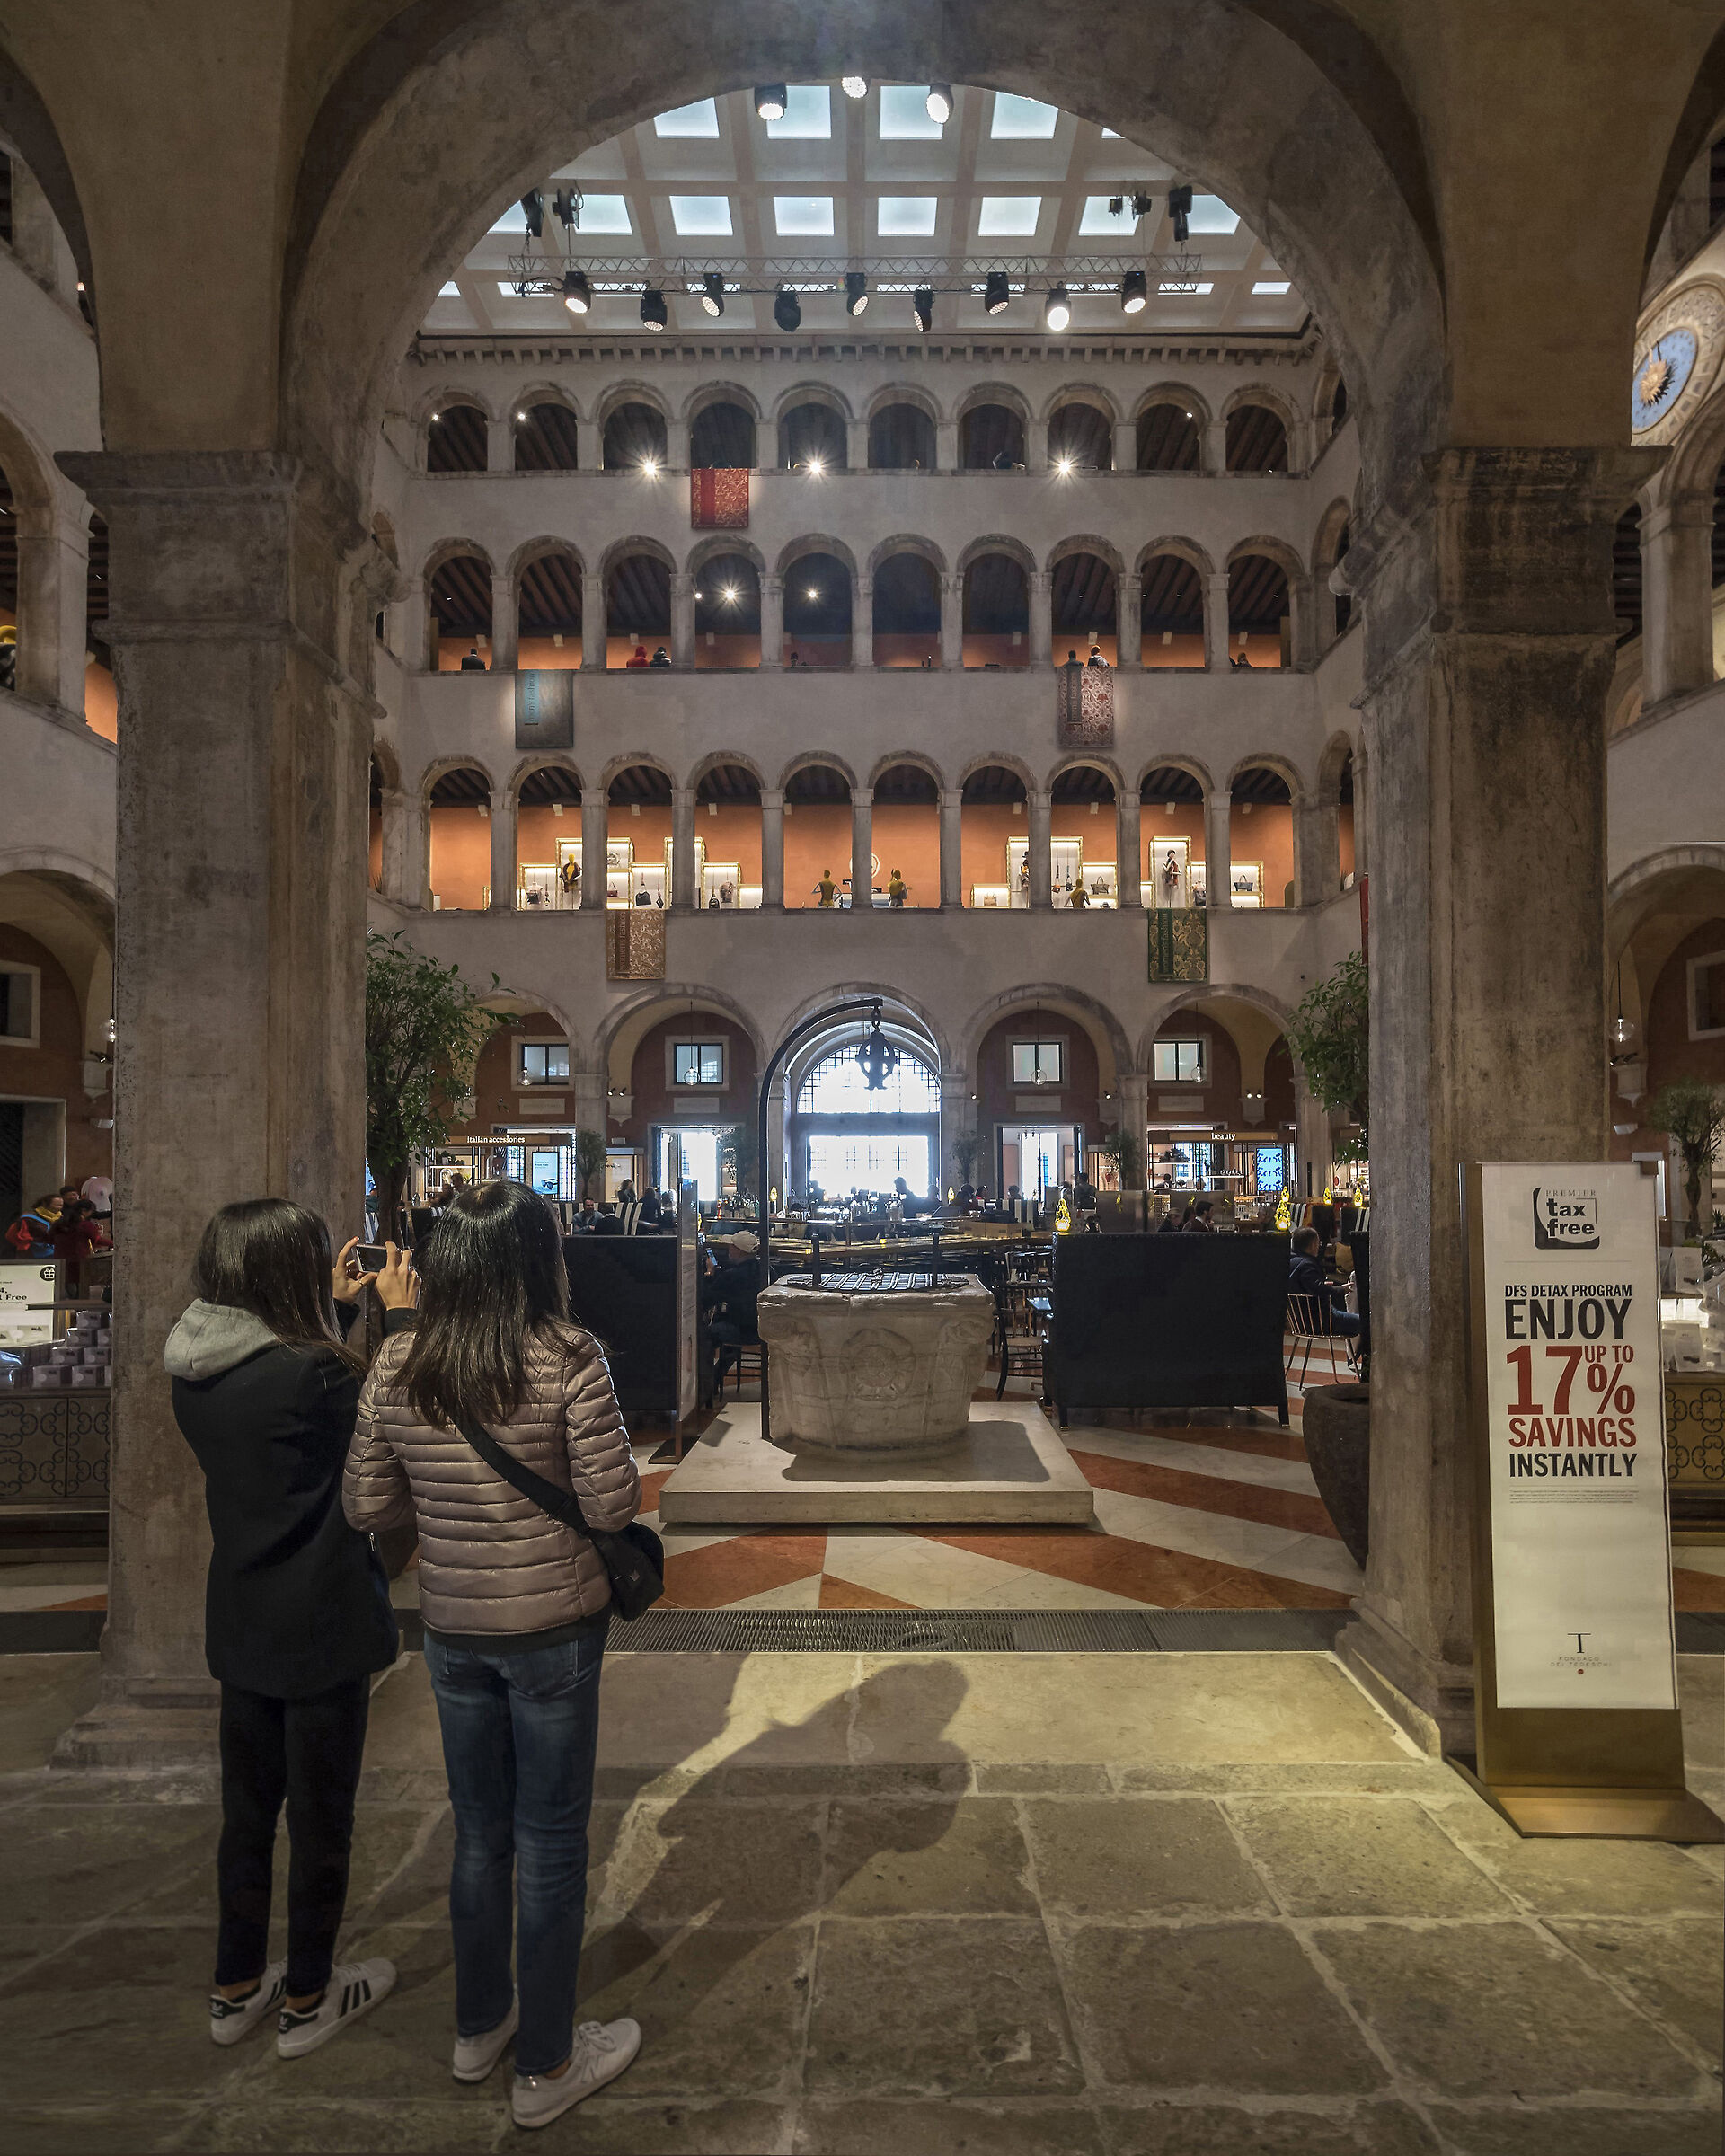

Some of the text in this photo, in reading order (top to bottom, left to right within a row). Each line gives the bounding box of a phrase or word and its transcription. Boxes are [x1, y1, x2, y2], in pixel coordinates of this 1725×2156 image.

[618, 911, 626, 939] fashion
[1161, 913, 1169, 941] fashion
[489, 1135, 526, 1144] accessories
[1211, 1132, 1236, 1141] beauty
[1545, 1188, 1597, 1197] PREMIER
[1546, 1197, 1587, 1217] tax
[1547, 1218, 1596, 1239] free
[1505, 1284, 1632, 1297] DFS DETAX PROGRAM
[1505, 1299, 1632, 1340] ENJOY
[1585, 1345, 1634, 1363] UP TO
[1506, 1345, 1635, 1415] 17%
[1508, 1418, 1637, 1448] SAVINGS
[1509, 1453, 1638, 1478] INSTANTLY
[1567, 1632, 1591, 1654] T
